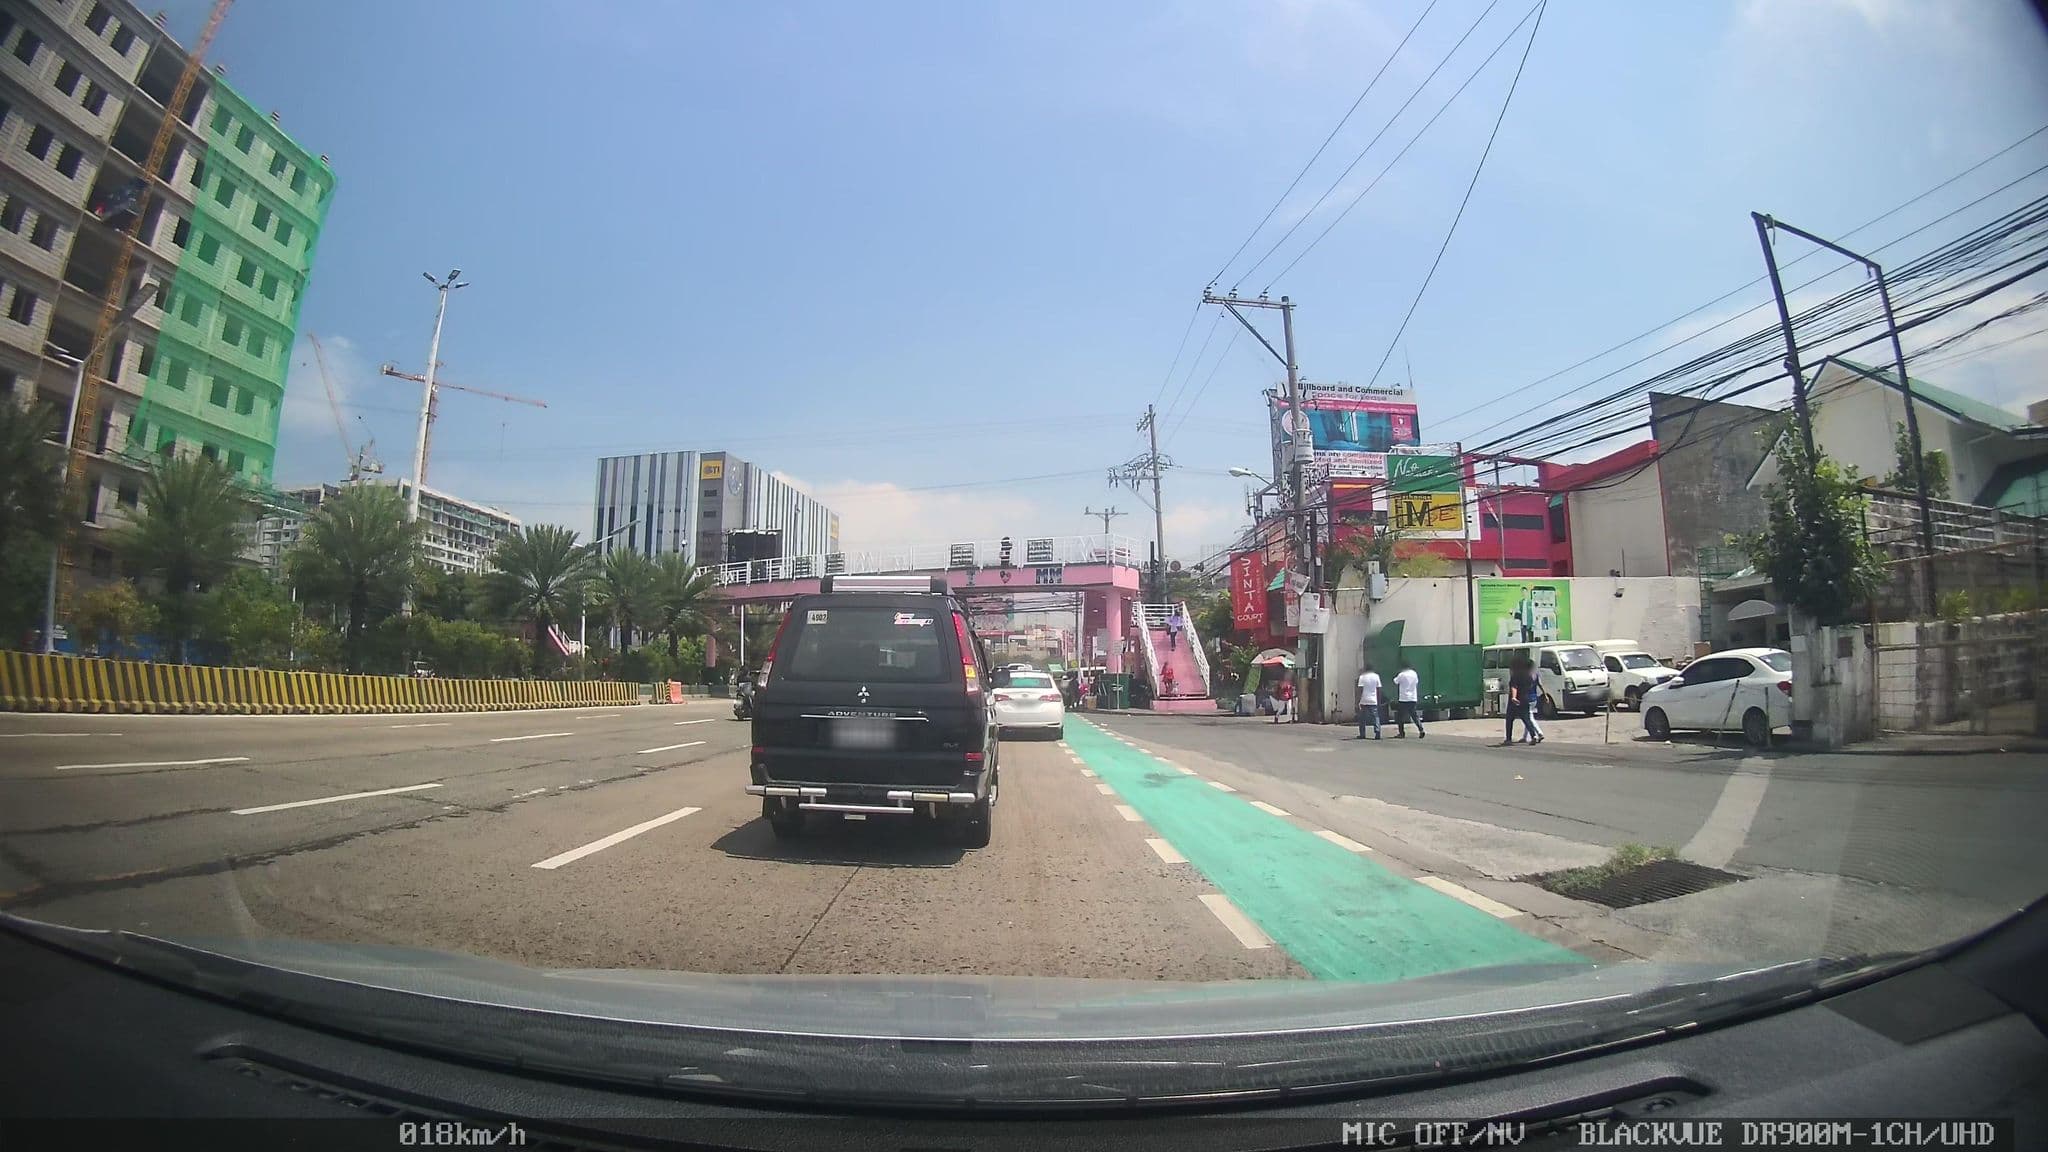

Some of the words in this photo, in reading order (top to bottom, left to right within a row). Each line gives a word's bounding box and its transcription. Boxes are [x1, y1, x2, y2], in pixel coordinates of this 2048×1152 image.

[1297, 383, 1336, 392] Billboard
[1355, 387, 1403, 397] Commercial
[1239, 557, 1257, 613] SINTA
[1236, 612, 1264, 622] COURT
